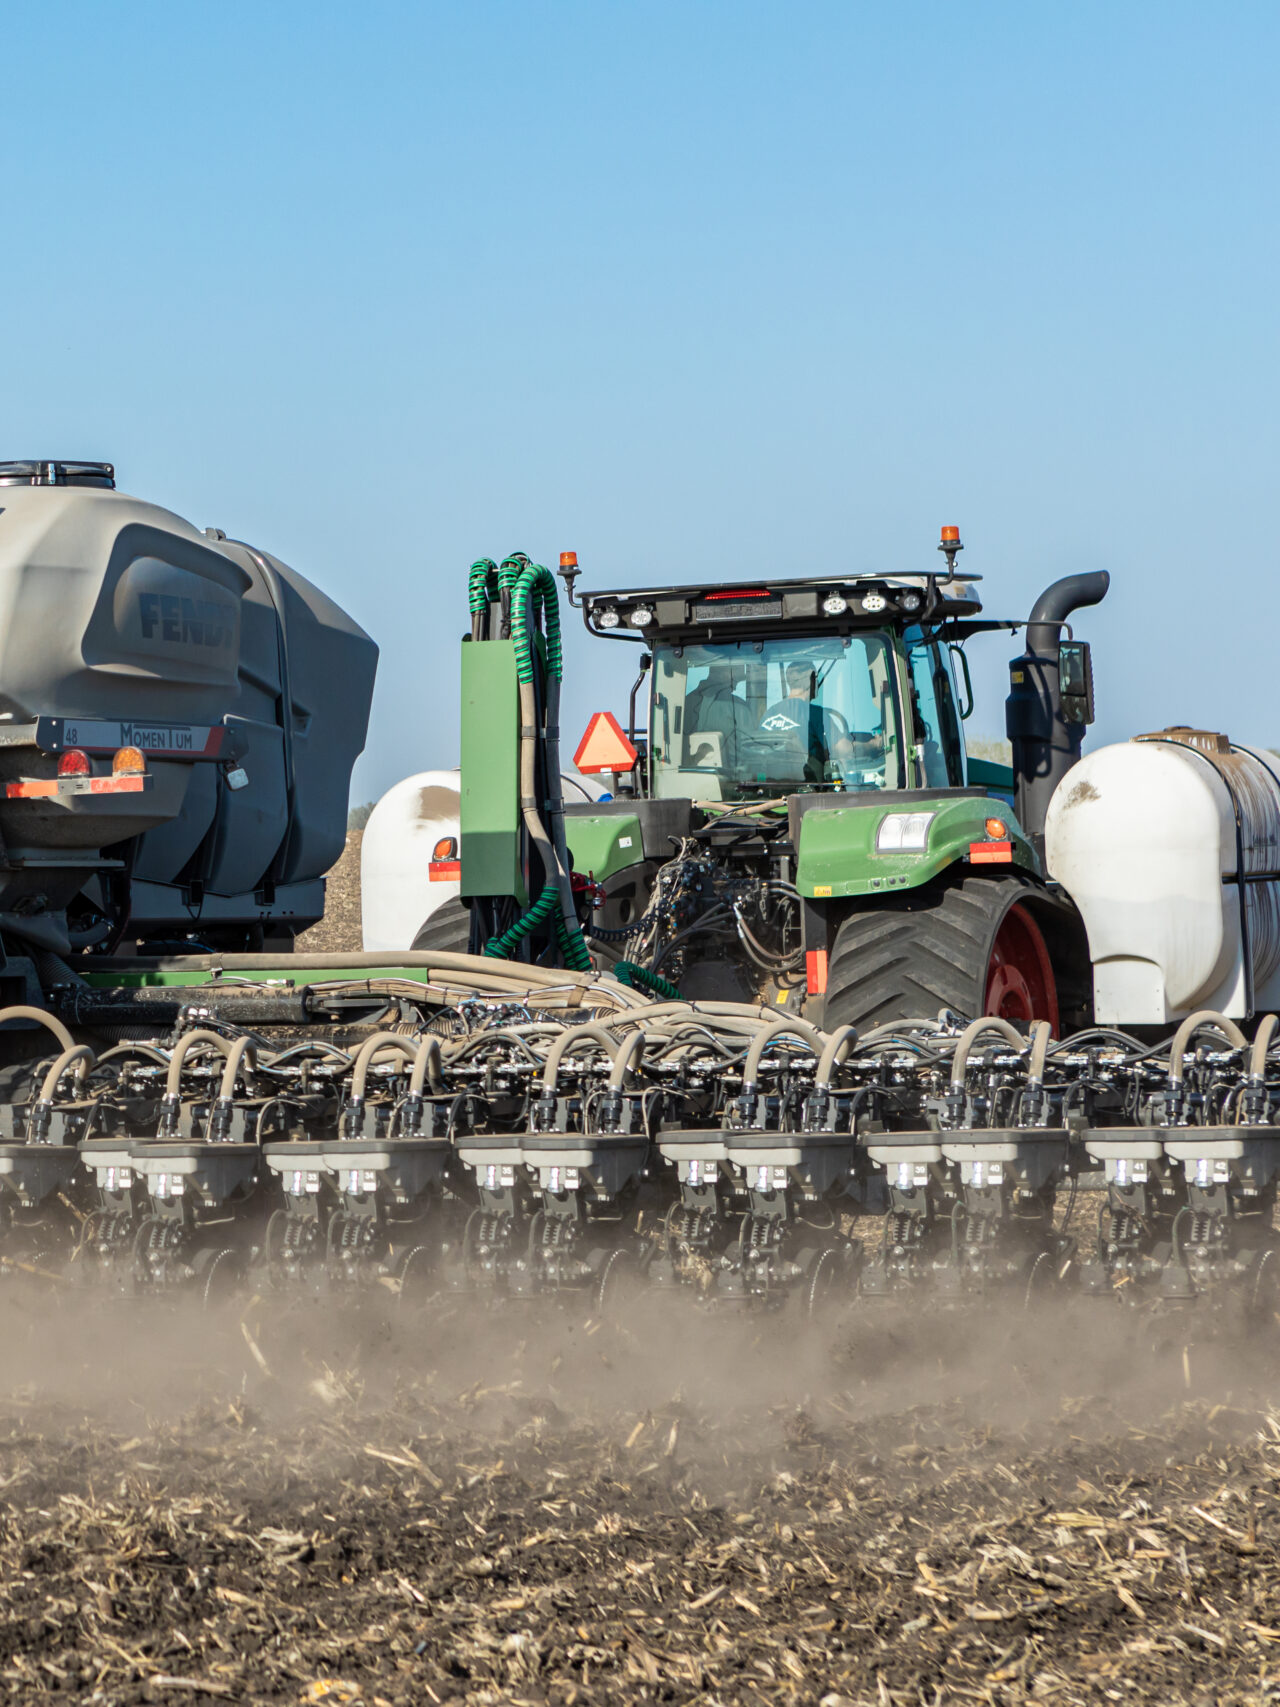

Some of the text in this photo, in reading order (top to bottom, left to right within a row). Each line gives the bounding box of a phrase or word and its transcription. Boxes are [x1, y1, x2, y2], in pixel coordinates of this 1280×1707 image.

[65, 728, 78, 745] 48
[914, 1166, 925, 1174] 39
[989, 1164, 1000, 1172] 40
[1214, 1162, 1226, 1170] 42
[566, 1169, 576, 1177] 36
[173, 1175, 182, 1183] 32
